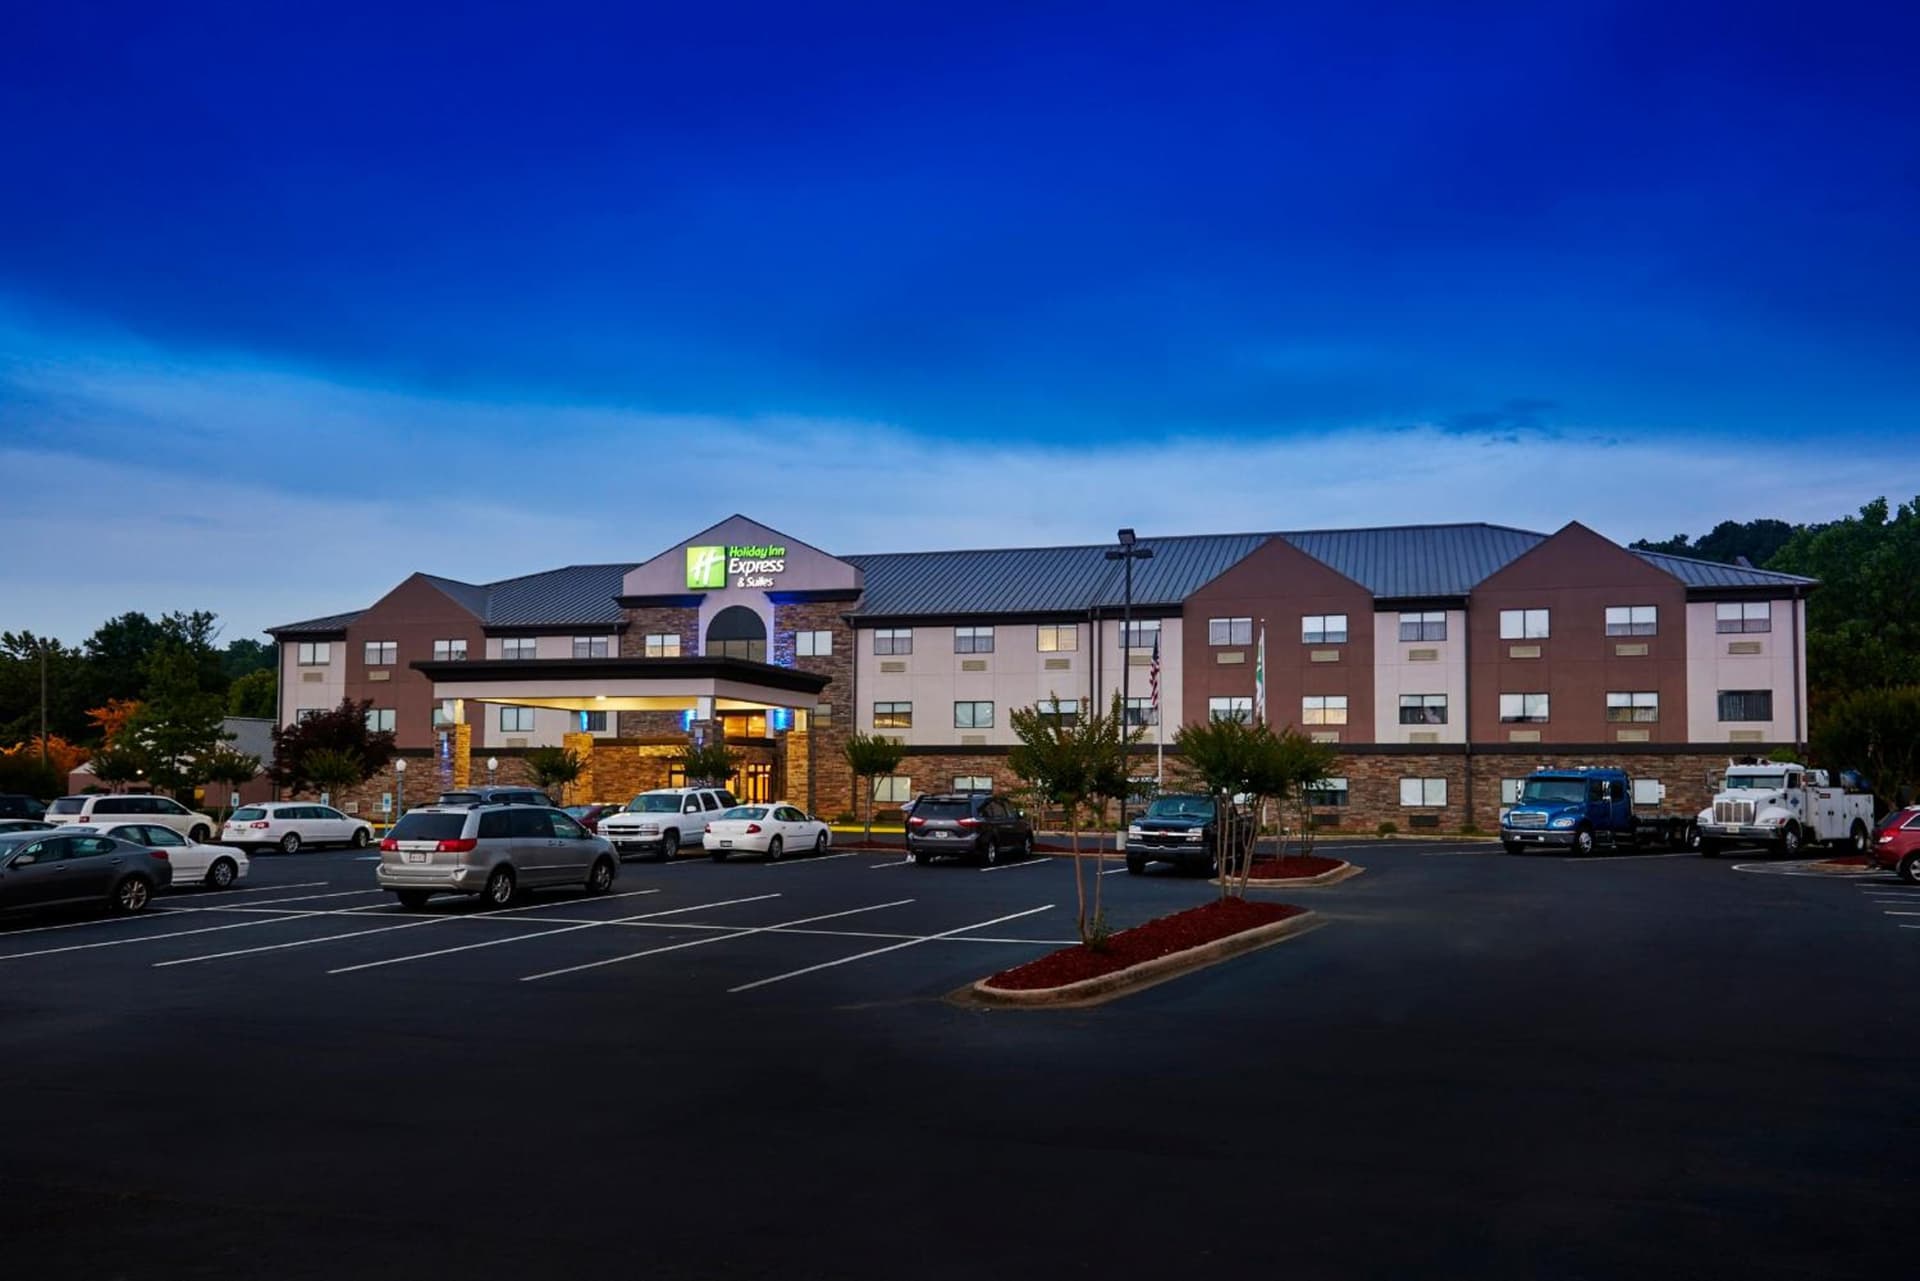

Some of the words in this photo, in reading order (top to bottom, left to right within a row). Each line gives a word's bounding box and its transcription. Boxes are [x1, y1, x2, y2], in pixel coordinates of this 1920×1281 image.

[730, 546, 768, 558] Holiday
[769, 545, 785, 556] Inn
[729, 558, 784, 576] Express
[737, 577, 745, 587] &
[746, 576, 774, 587] Suites
